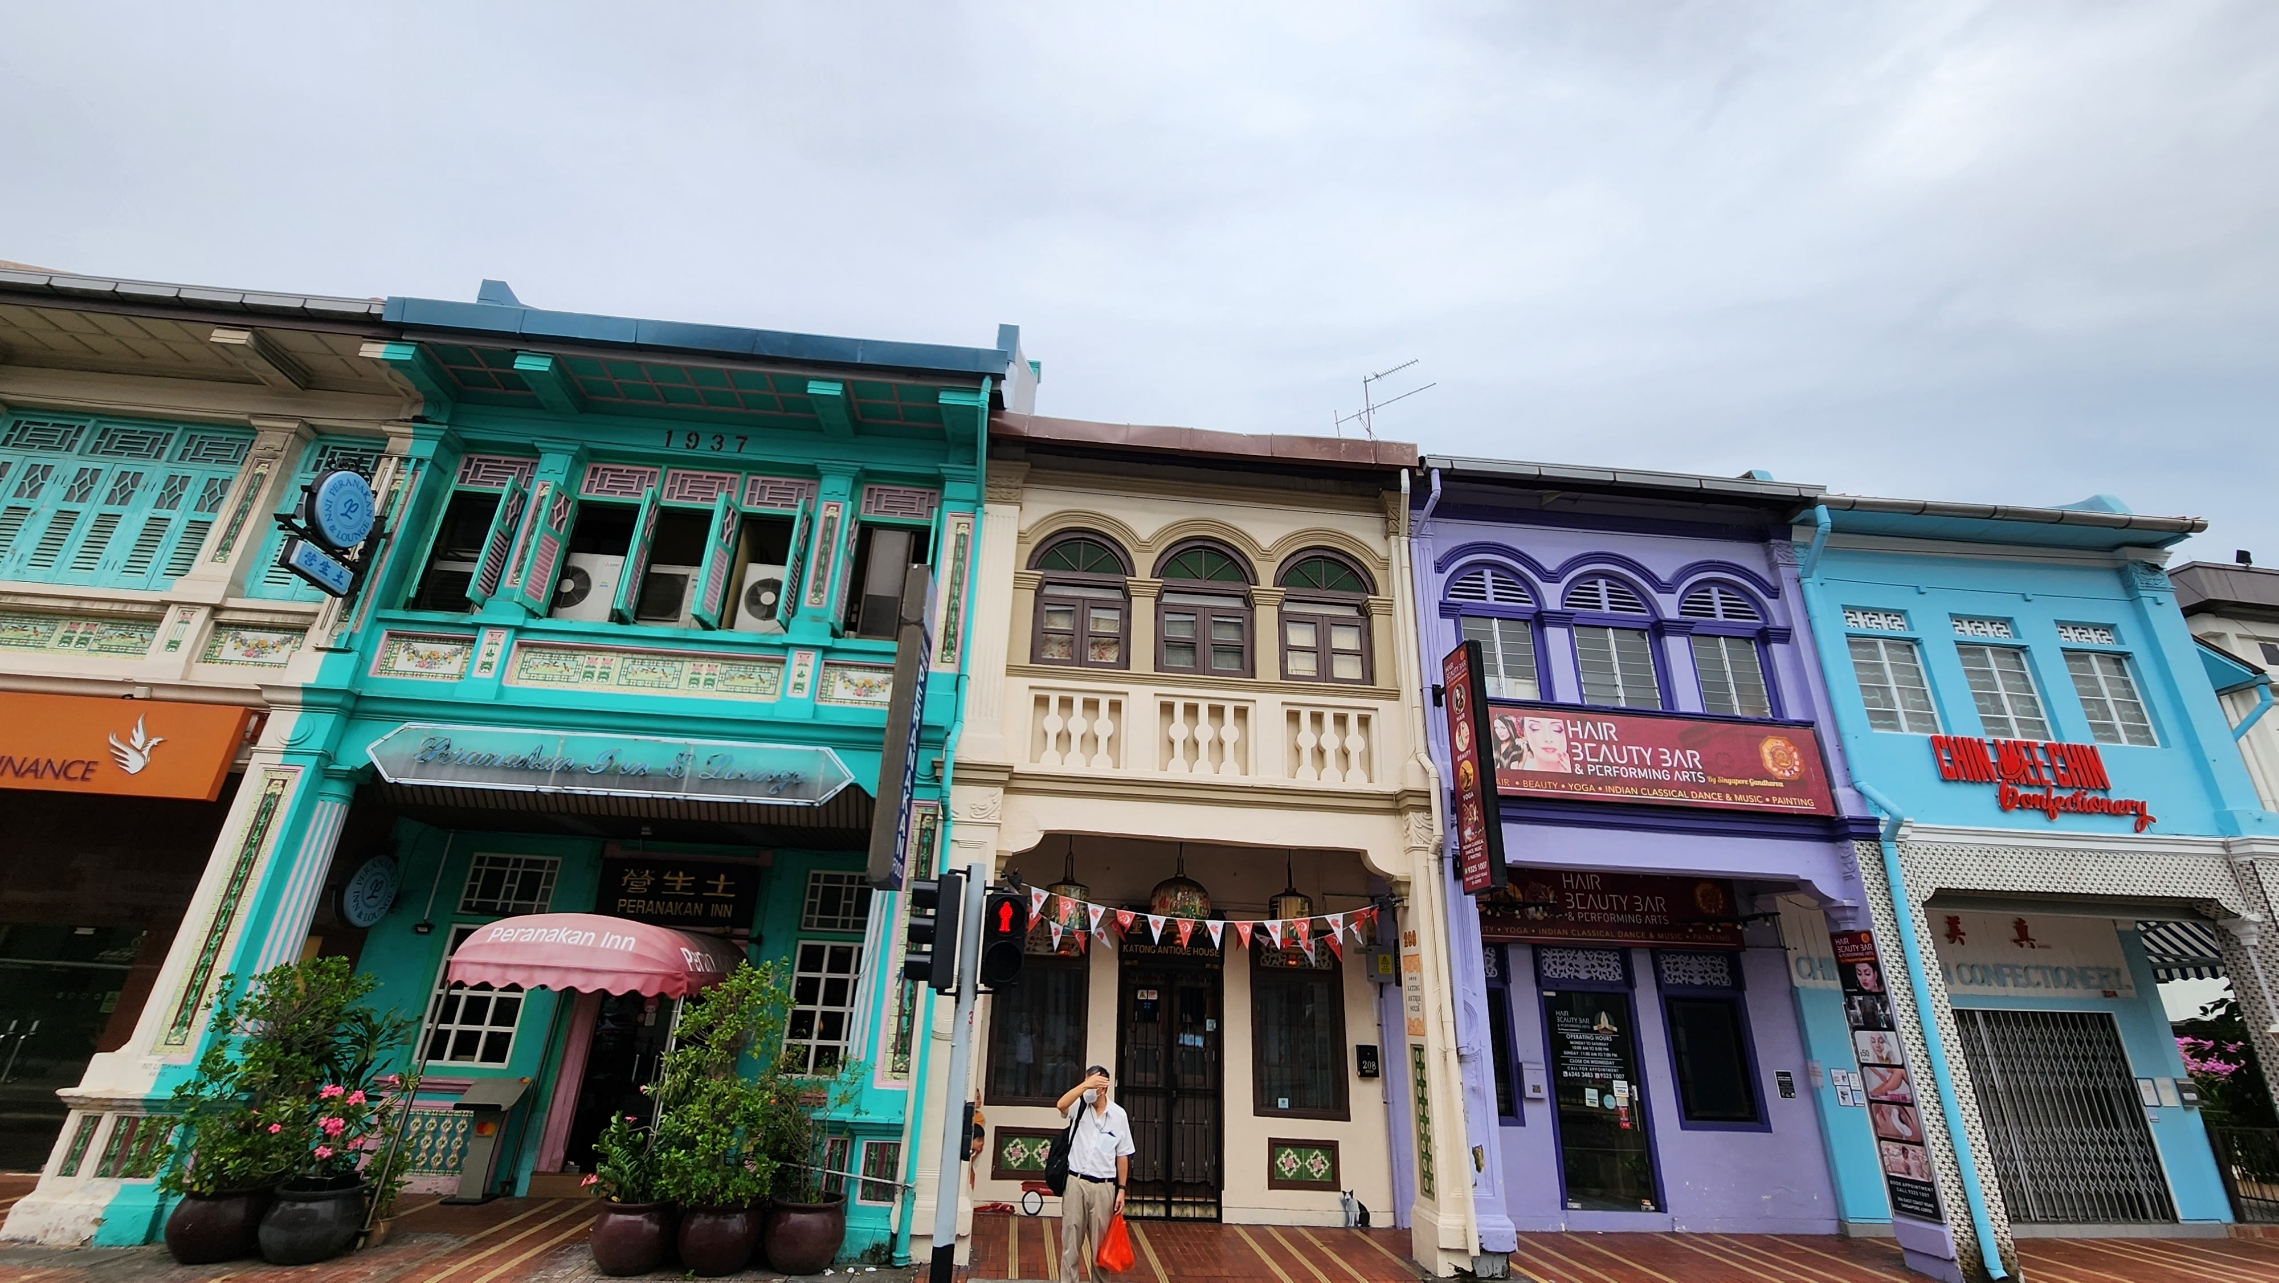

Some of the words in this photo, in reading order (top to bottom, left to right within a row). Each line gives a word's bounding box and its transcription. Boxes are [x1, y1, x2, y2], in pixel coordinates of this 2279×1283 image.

[665, 429, 749, 454] 1937
[329, 478, 373, 518] PERANAKAN
[324, 499, 333, 522] INN
[329, 523, 338, 533] &
[335, 521, 371, 542] LOUNGE
[1456, 712, 1465, 722] HAIR
[1566, 719, 1619, 742] HAIR
[412, 736, 575, 772] Peranakan
[585, 747, 650, 777] Inn
[698, 752, 808, 795] Lounge
[896, 663, 925, 859] PERANAKAN
[1457, 749, 1471, 762] BEAUTY
[1570, 742, 1653, 766] BEAUTY
[1658, 747, 1703, 770] BAR
[1930, 735, 1997, 782] CHIN
[1992, 739, 2053, 787] MEE
[2044, 742, 2112, 790] CHIN
[1574, 763, 1585, 775] &
[1588, 765, 1671, 781] PERFORMING
[1674, 769, 1706, 784] ARTS
[1707, 776, 1716, 785] By
[1717, 776, 1749, 787] Singapore
[1462, 791, 1474, 801] YOGA
[1496, 778, 1510, 787] AIR
[1523, 780, 1558, 790] BEAUTY
[1568, 783, 1596, 792] YOGA
[1605, 786, 1638, 796] INDIAN
[1640, 788, 1689, 799] CLASSICAL
[1691, 791, 1723, 801] DANCE
[1725, 793, 1733, 802] &
[1734, 794, 1763, 804] MUSIC
[1772, 796, 1815, 807] PAINTING
[1997, 779, 2157, 833] Confectionery
[1561, 873, 1602, 891] HAIR
[616, 898, 703, 917] PERANAKAN
[710, 903, 733, 918] INN
[1564, 893, 1628, 911] BEAUTY
[1634, 896, 1667, 913] BAR
[1567, 912, 1575, 922] &
[1577, 912, 1642, 925] PERFORMING
[1644, 914, 1670, 926] ARTS
[487, 927, 596, 946] Peranakan
[600, 931, 636, 951] Inn
[1403, 930, 1417, 947] 208
[1504, 926, 1529, 935] YOGA
[1538, 927, 1569, 937] INDIAN
[1570, 928, 1616, 939] CLASSICAL
[1617, 930, 1646, 940] DANCE
[1649, 931, 1655, 940] &
[1657, 931, 1683, 941] MUSIC
[1692, 933, 1731, 943] PAINTING
[1835, 938, 1850, 946] HAIR
[1122, 944, 1156, 954] KATONG
[1192, 946, 1220, 957] HOUSE
[1838, 944, 1860, 953] BEAUTY
[1860, 943, 1873, 951] BAR
[1362, 1060, 1377, 1070] 208
